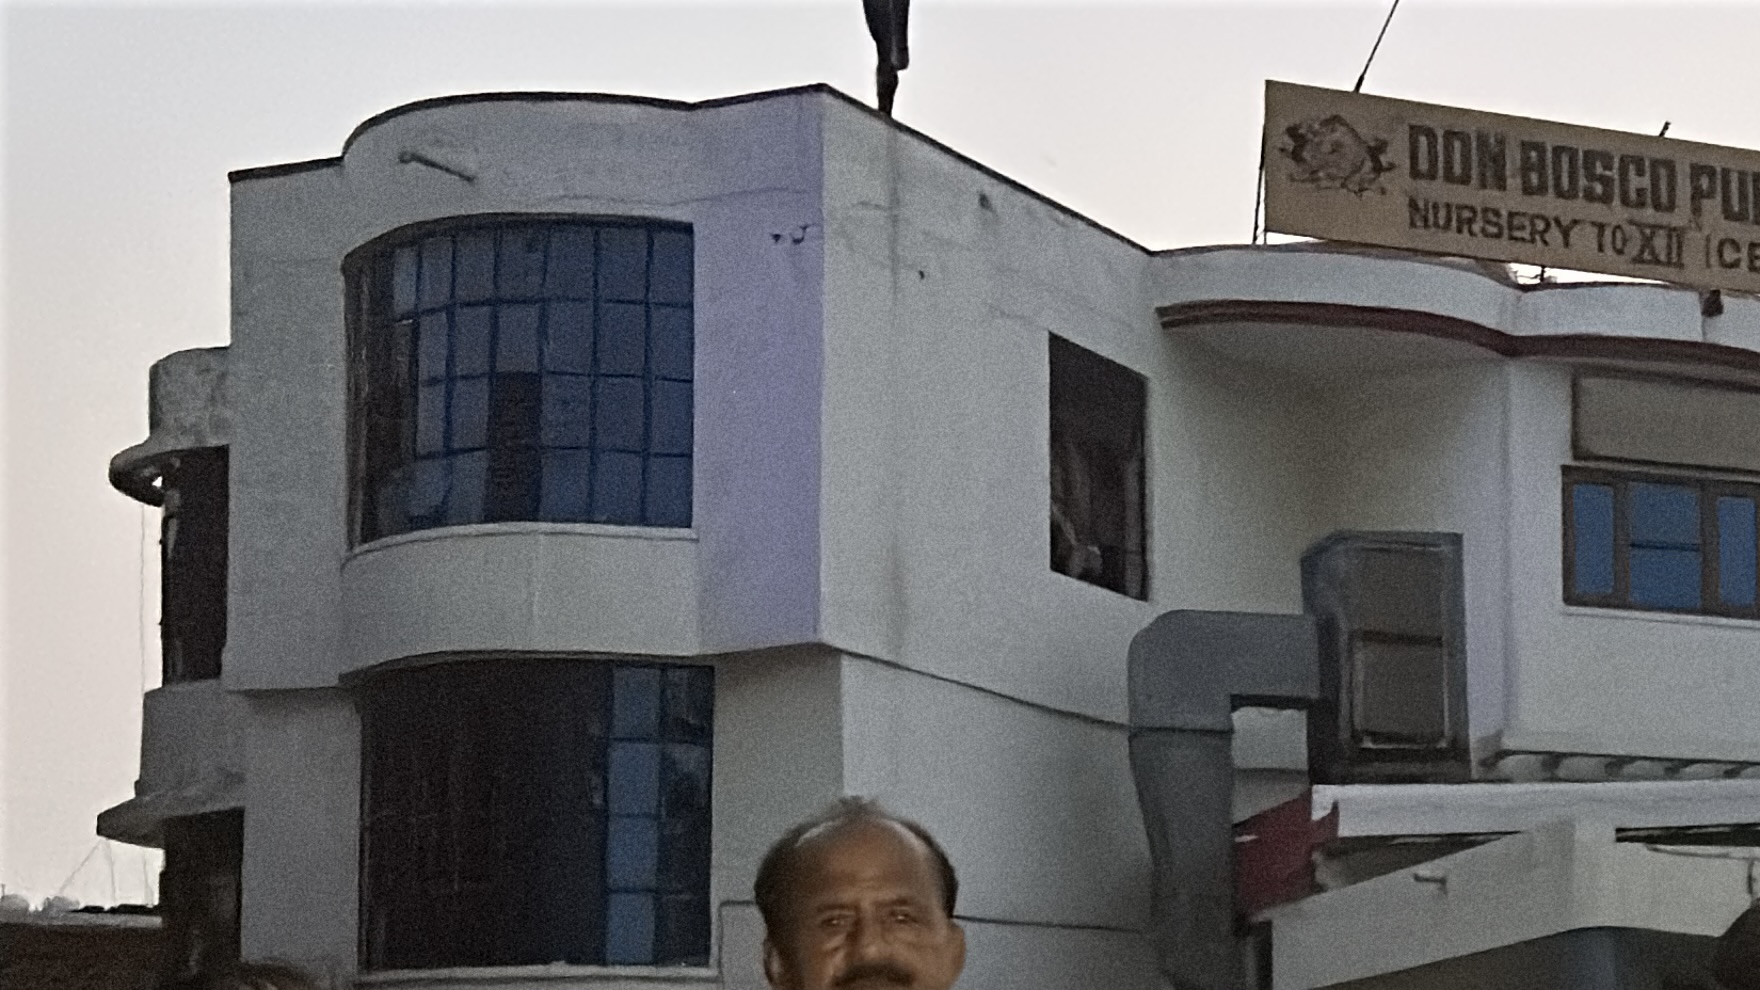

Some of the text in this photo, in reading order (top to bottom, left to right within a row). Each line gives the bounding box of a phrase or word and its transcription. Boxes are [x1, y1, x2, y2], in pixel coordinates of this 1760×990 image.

[1408, 123, 1507, 192] DON
[1520, 139, 1678, 213] BOSCO
[1408, 197, 1583, 249] NURSERY
[1592, 220, 1627, 256] TO
[1627, 218, 1686, 270] XII
